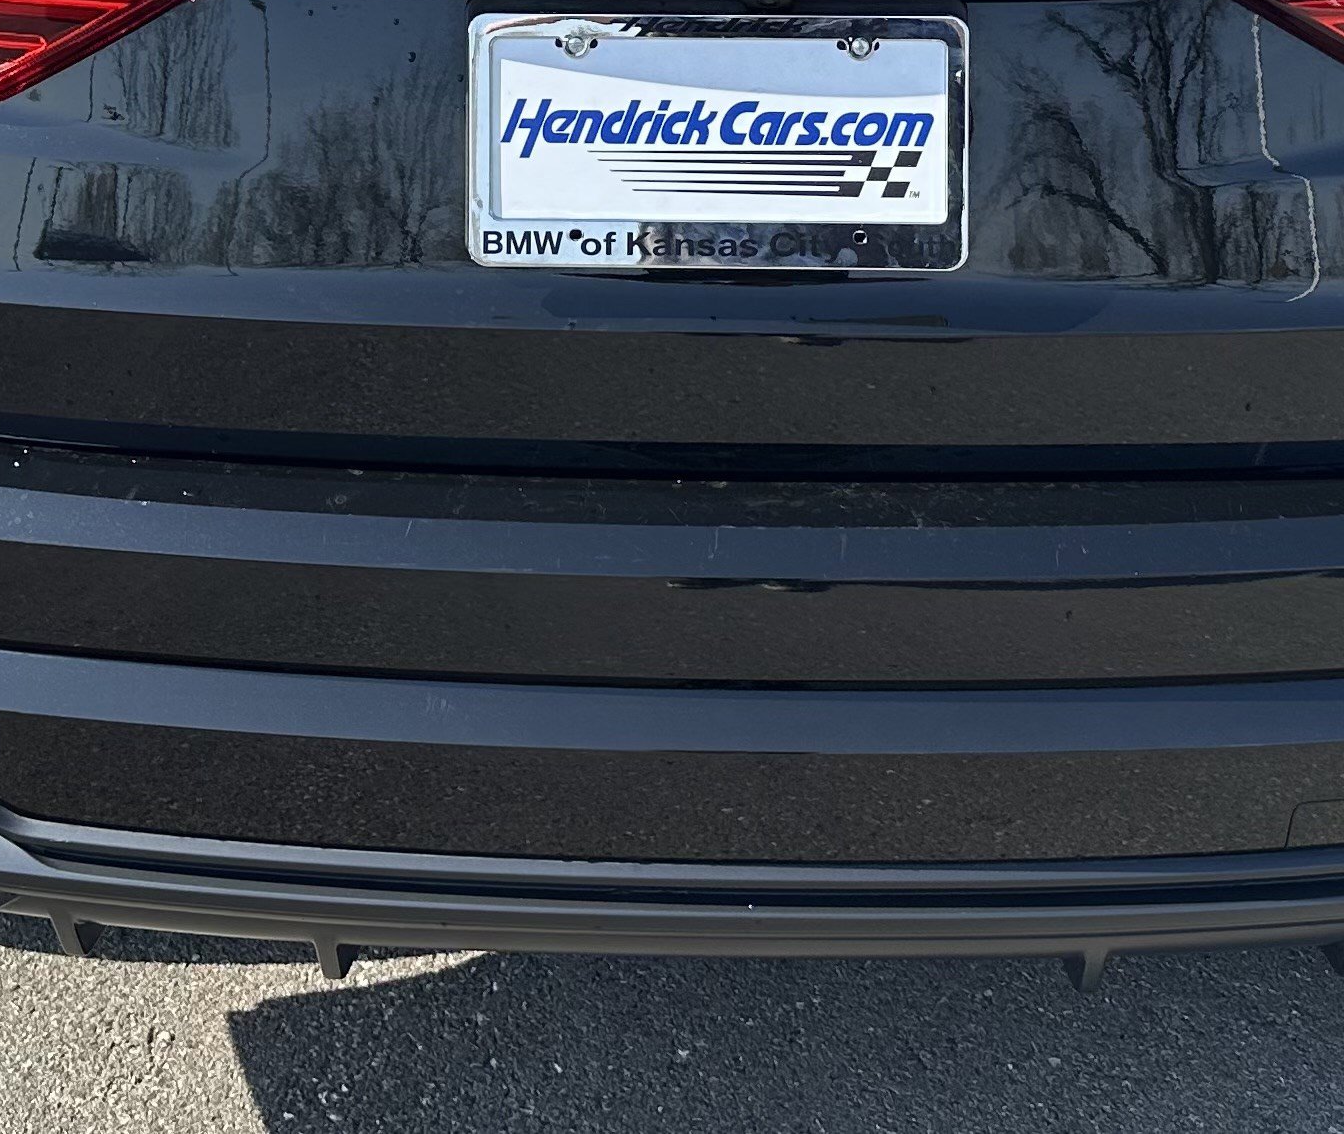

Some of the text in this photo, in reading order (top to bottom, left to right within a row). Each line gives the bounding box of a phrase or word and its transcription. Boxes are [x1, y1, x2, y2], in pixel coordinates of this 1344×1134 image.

[500, 98, 935, 158] HendrickCars.com
[482, 230, 564, 255] BMW
[580, 231, 617, 256] of
[626, 232, 758, 258] Kansas
